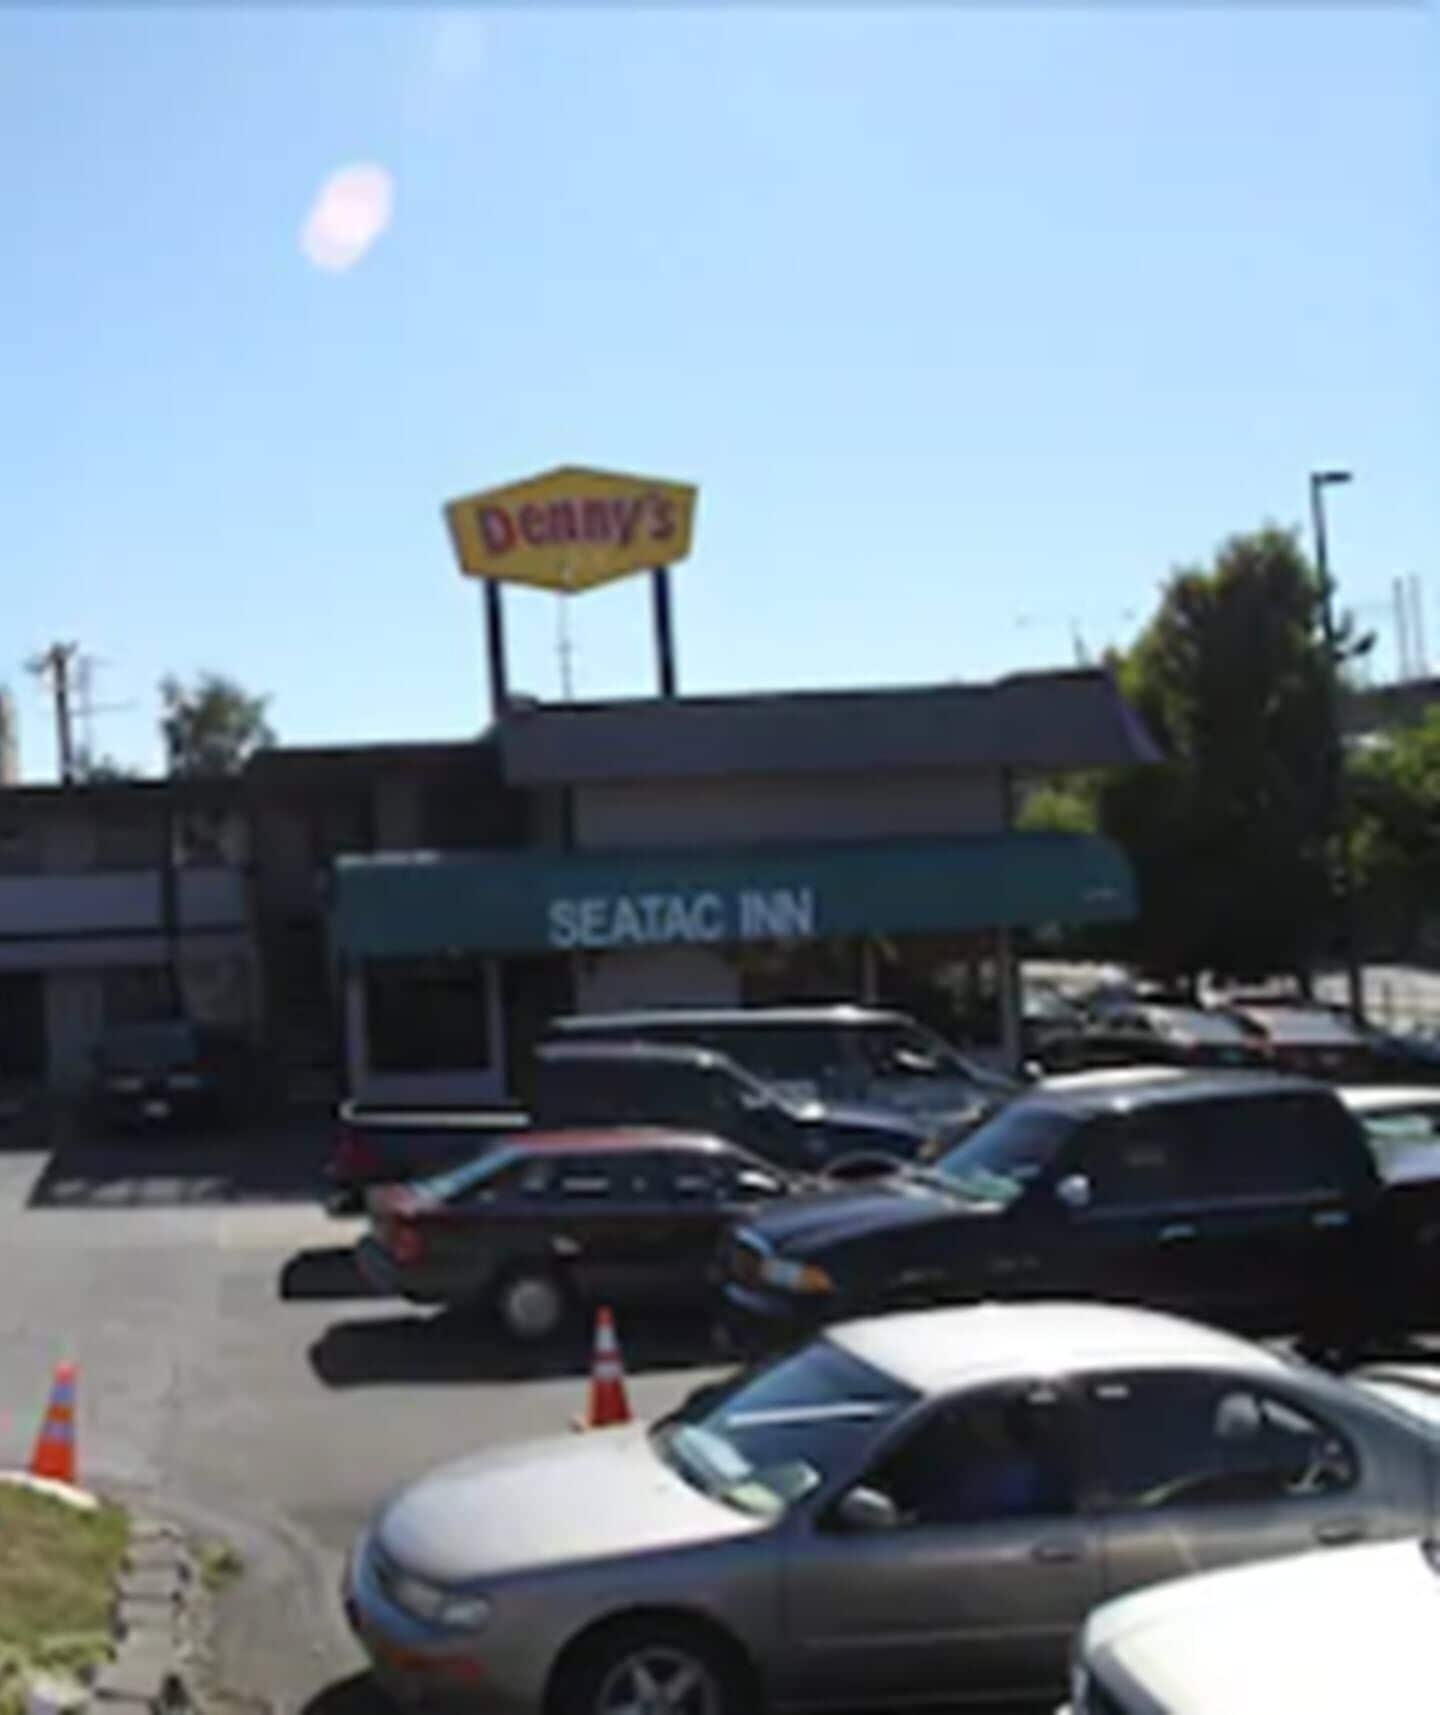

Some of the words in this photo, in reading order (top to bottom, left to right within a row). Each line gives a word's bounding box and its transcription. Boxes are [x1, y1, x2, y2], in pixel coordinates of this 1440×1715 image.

[477, 491, 677, 557] Denny's
[548, 893, 723, 948] SEATAC
[739, 886, 815, 938] INN
